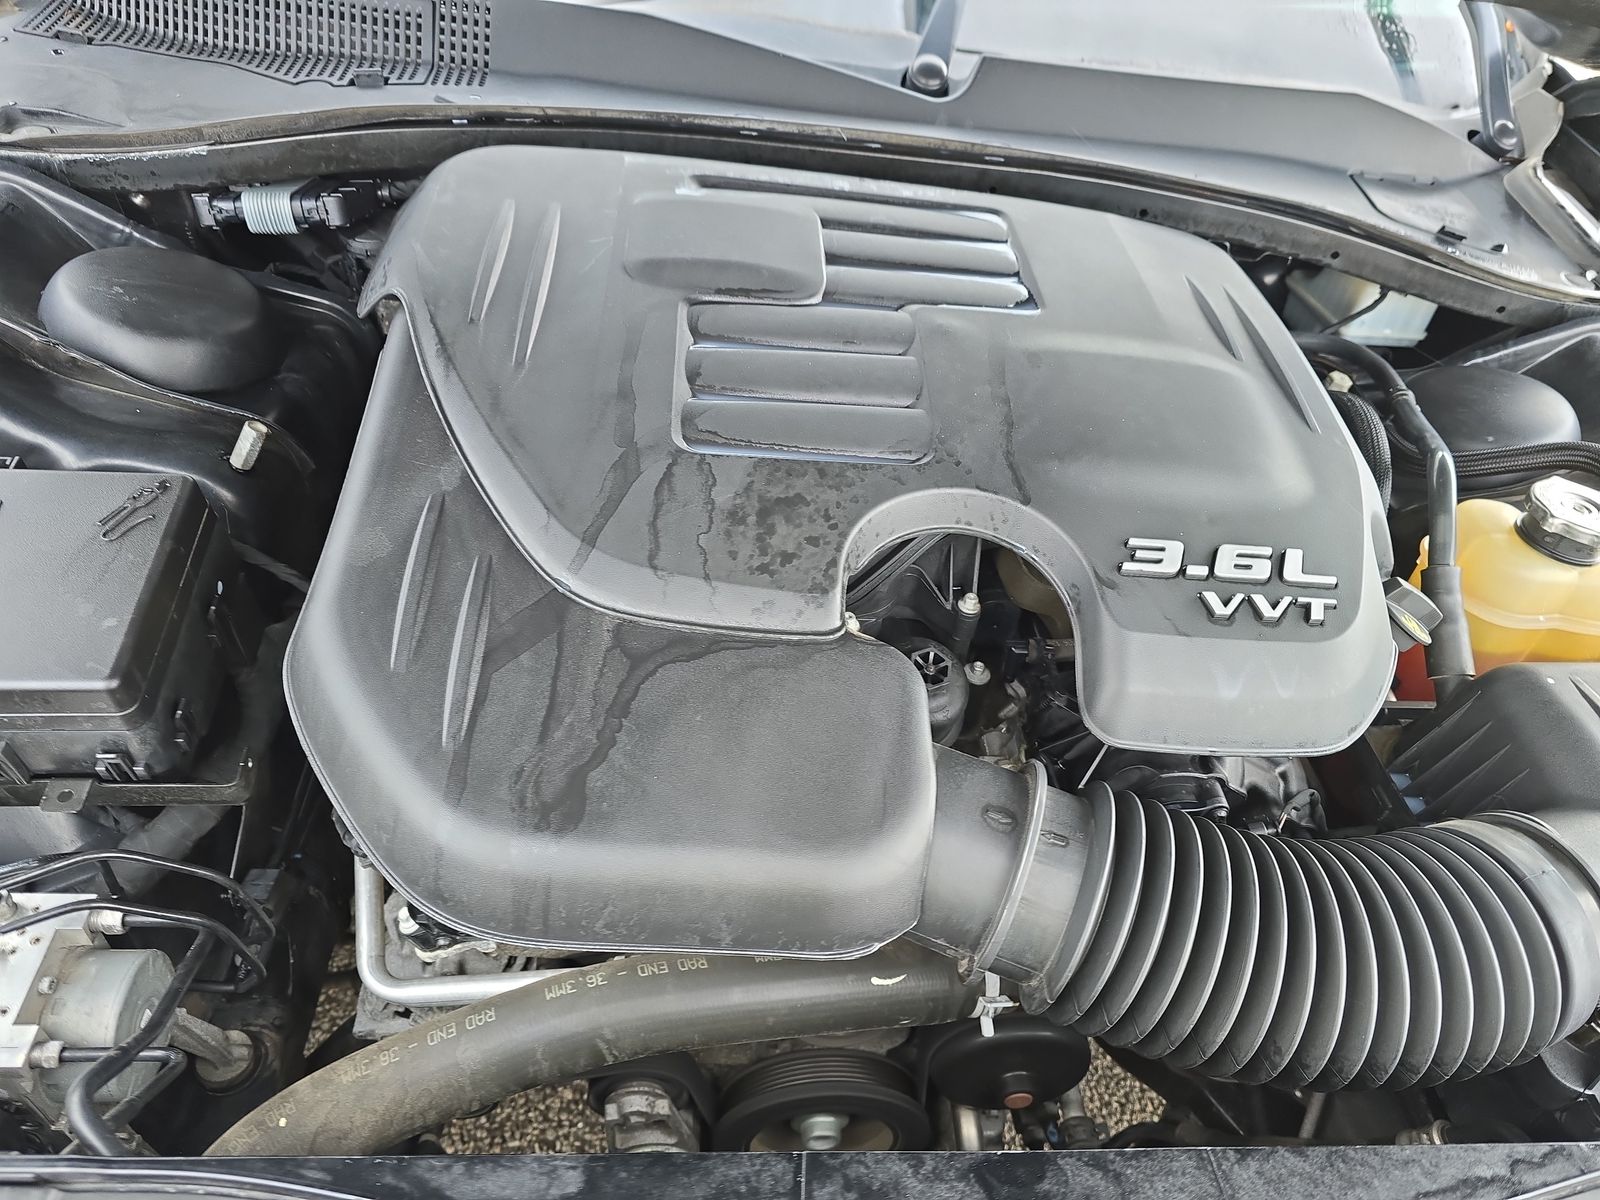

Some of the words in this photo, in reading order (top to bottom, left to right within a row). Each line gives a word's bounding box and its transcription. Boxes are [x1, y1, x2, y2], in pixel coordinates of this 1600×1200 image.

[1119, 537, 1338, 587] 3.6L
[1198, 590, 1338, 624] VVT
[637, 960, 669, 977] END
[675, 955, 709, 972] RAD
[544, 971, 608, 1001] 36.3MM
[465, 1007, 496, 1030] RAD
[427, 1022, 457, 1046] END
